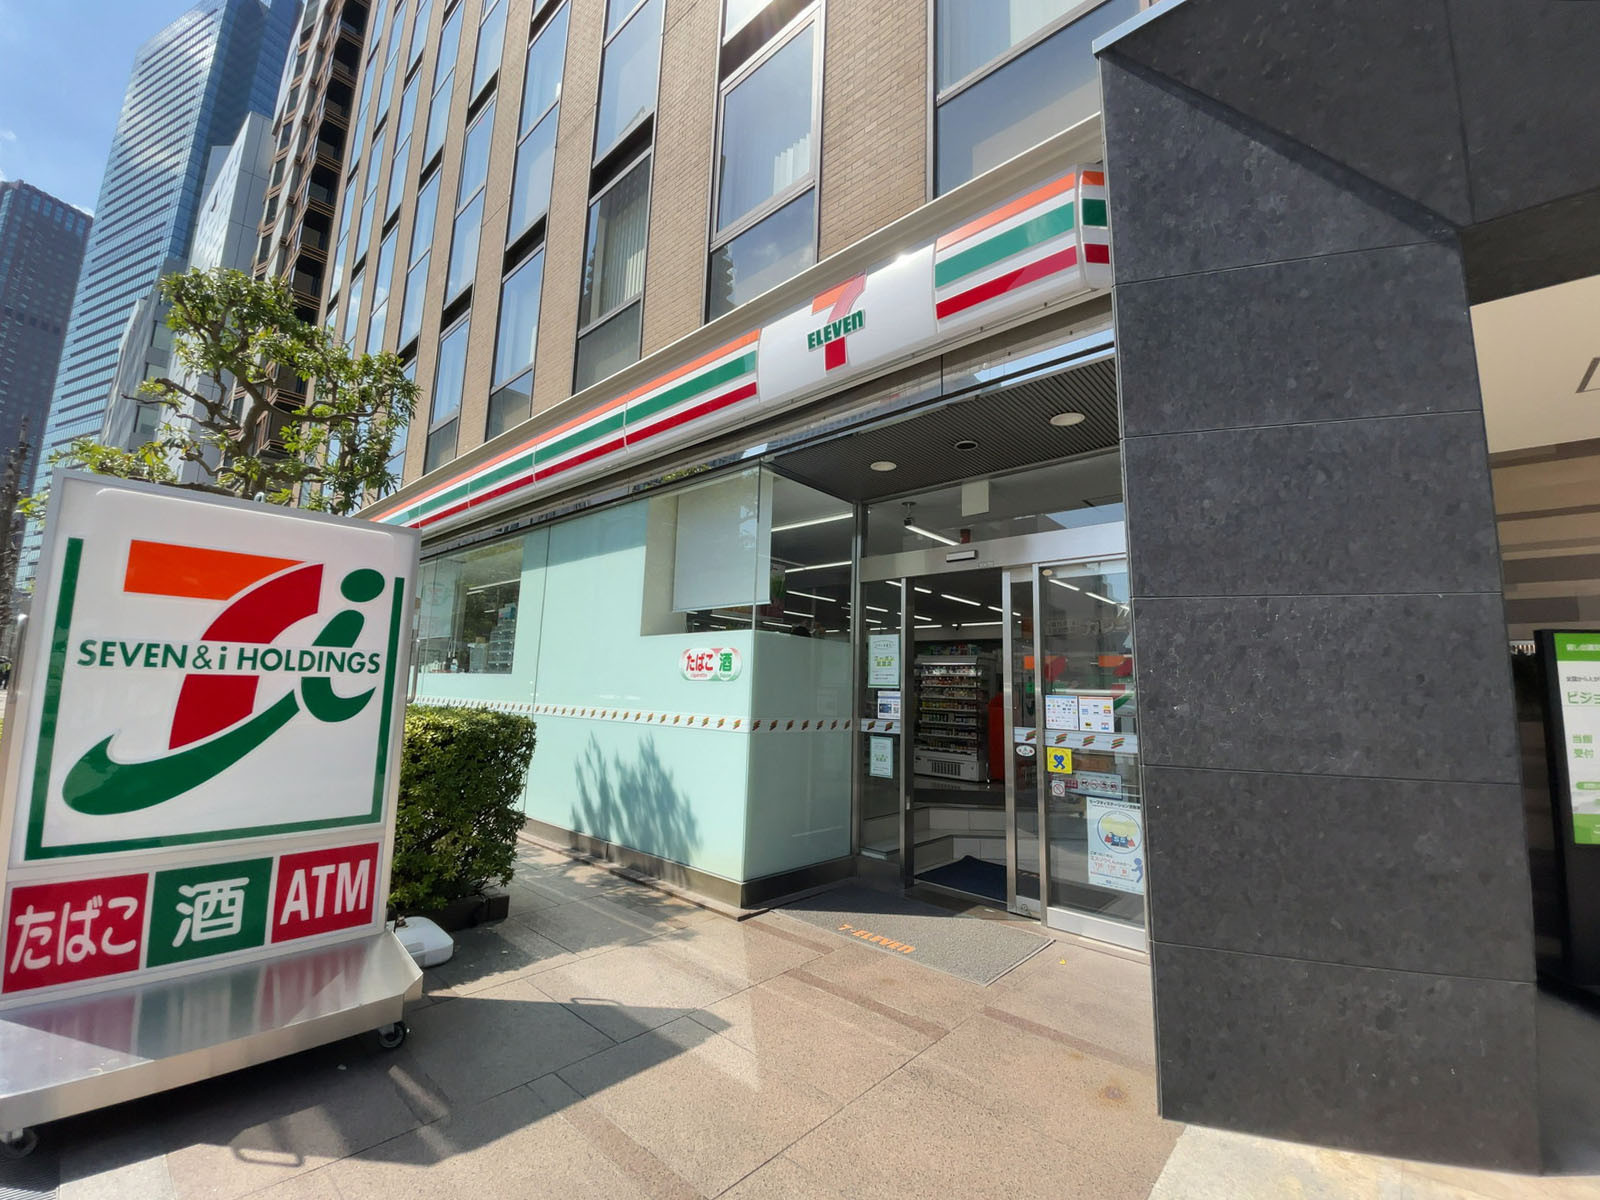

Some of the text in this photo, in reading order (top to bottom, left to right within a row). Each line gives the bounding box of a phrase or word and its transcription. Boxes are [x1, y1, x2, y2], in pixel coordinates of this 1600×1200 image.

[237, 646, 381, 674] HOLDINGS
[686, 652, 733, 671] たばこ 酒
[10, 859, 371, 974] たばこ 酒 ATM
